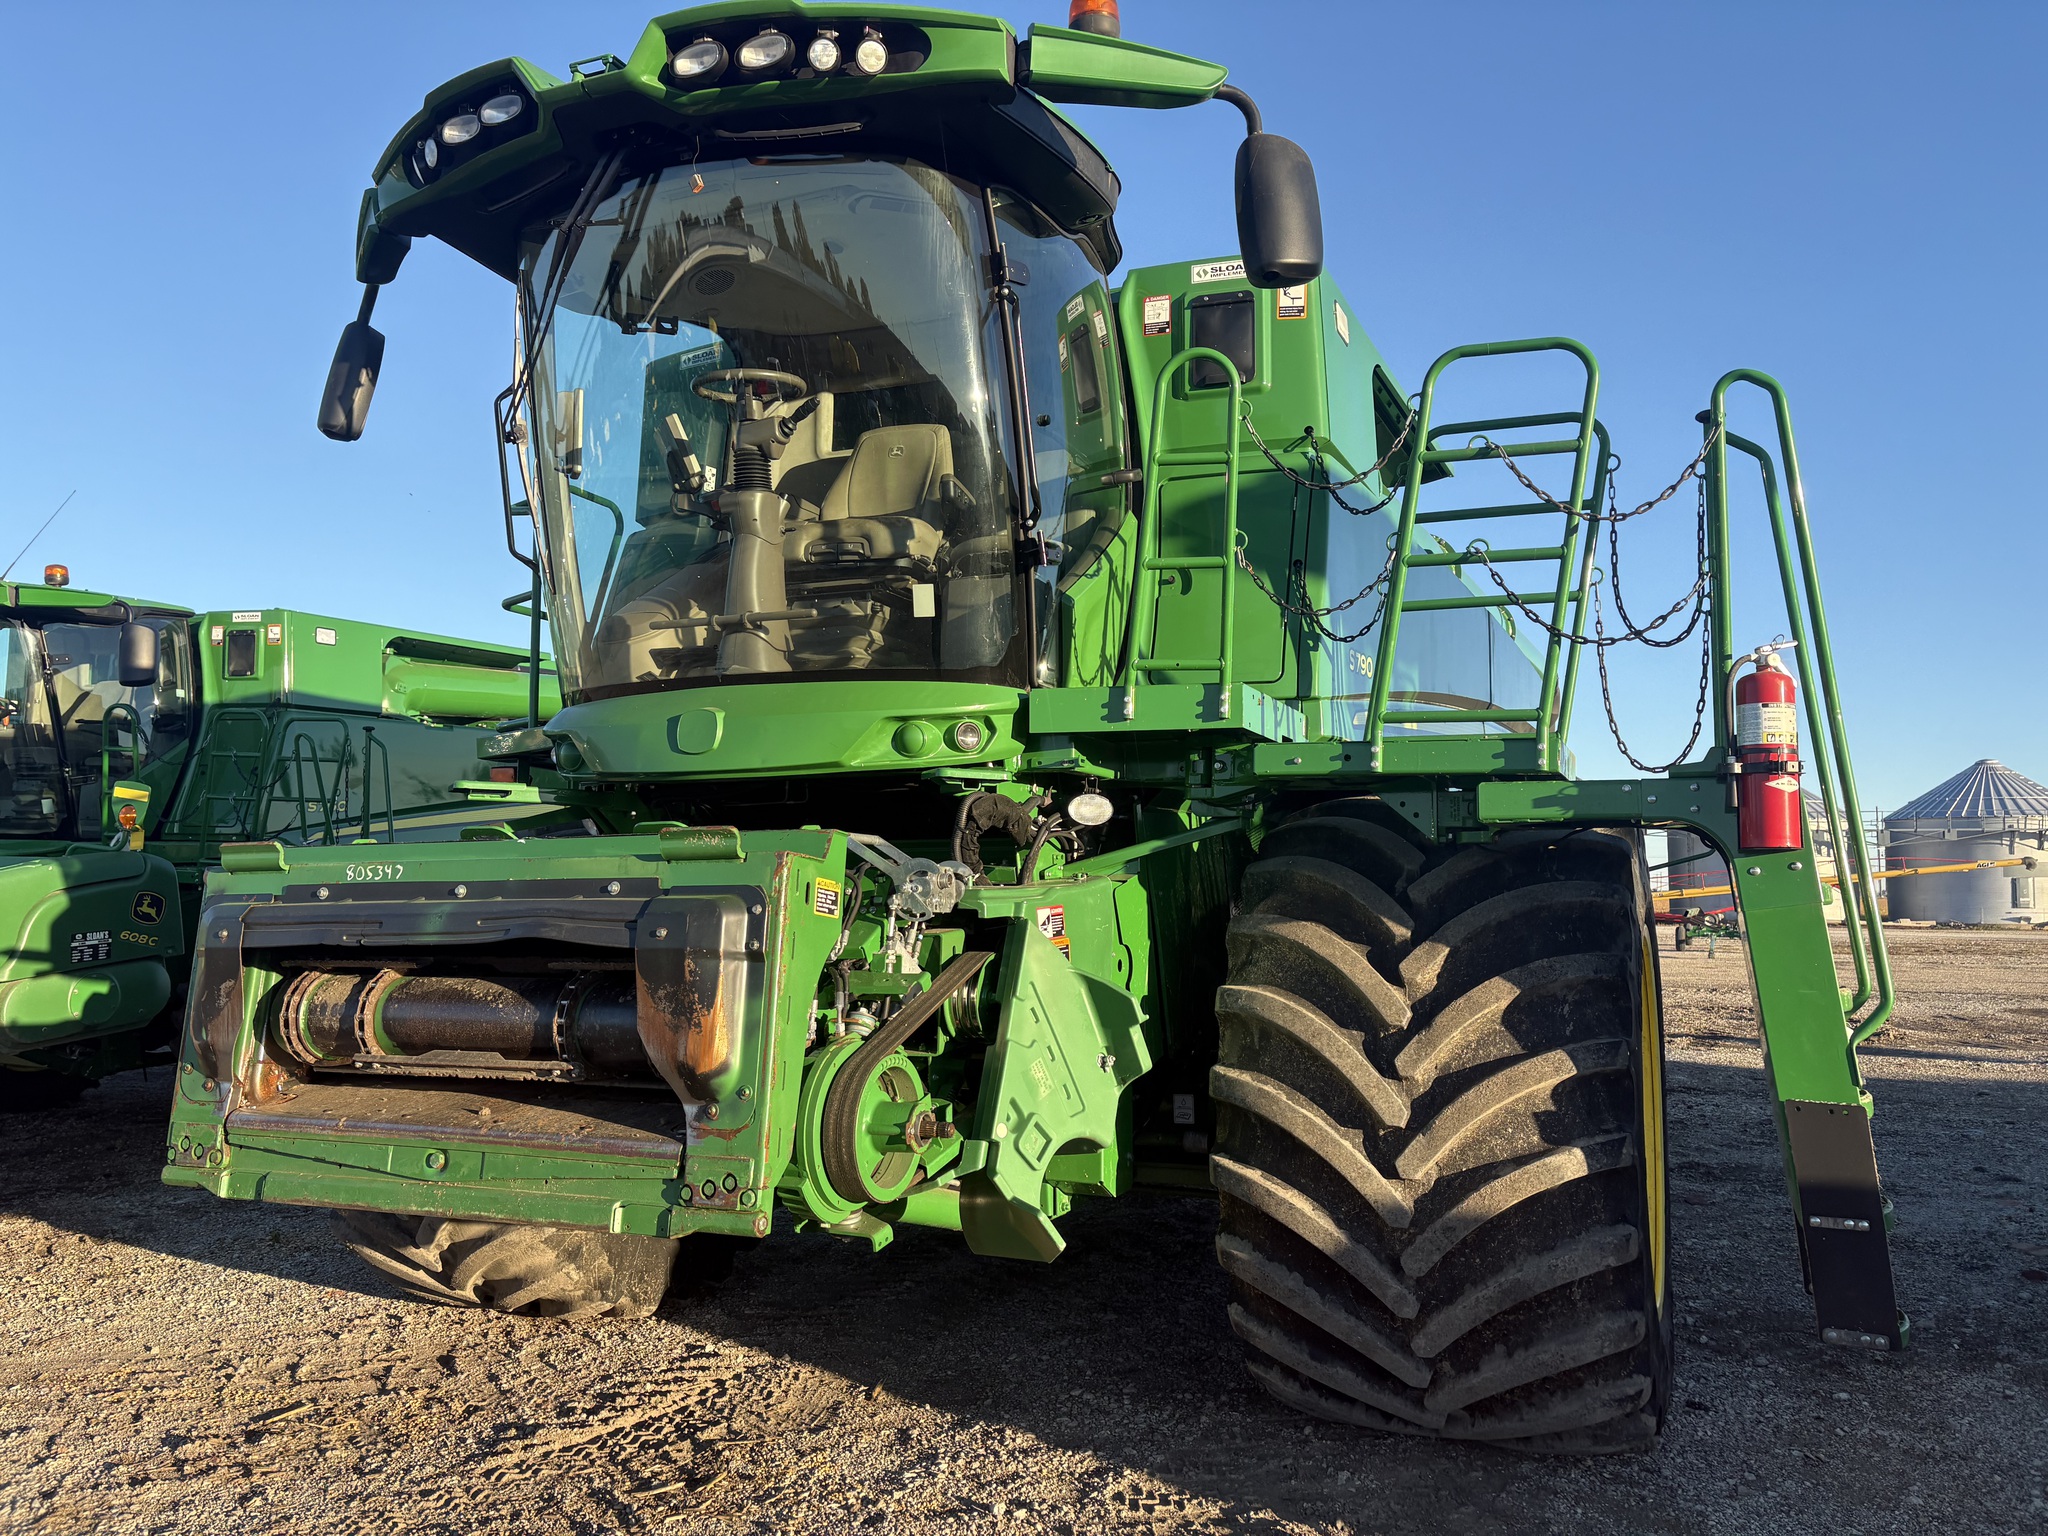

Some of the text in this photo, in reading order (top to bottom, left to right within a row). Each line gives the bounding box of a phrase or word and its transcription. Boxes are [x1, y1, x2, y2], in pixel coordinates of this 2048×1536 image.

[1210, 264, 1244, 273] SLOA
[1210, 270, 1246, 278] IMPLEME
[1349, 649, 1373, 678] S790
[307, 801, 346, 812] S70
[346, 864, 404, 881] 805347
[120, 930, 158, 946] 608C
